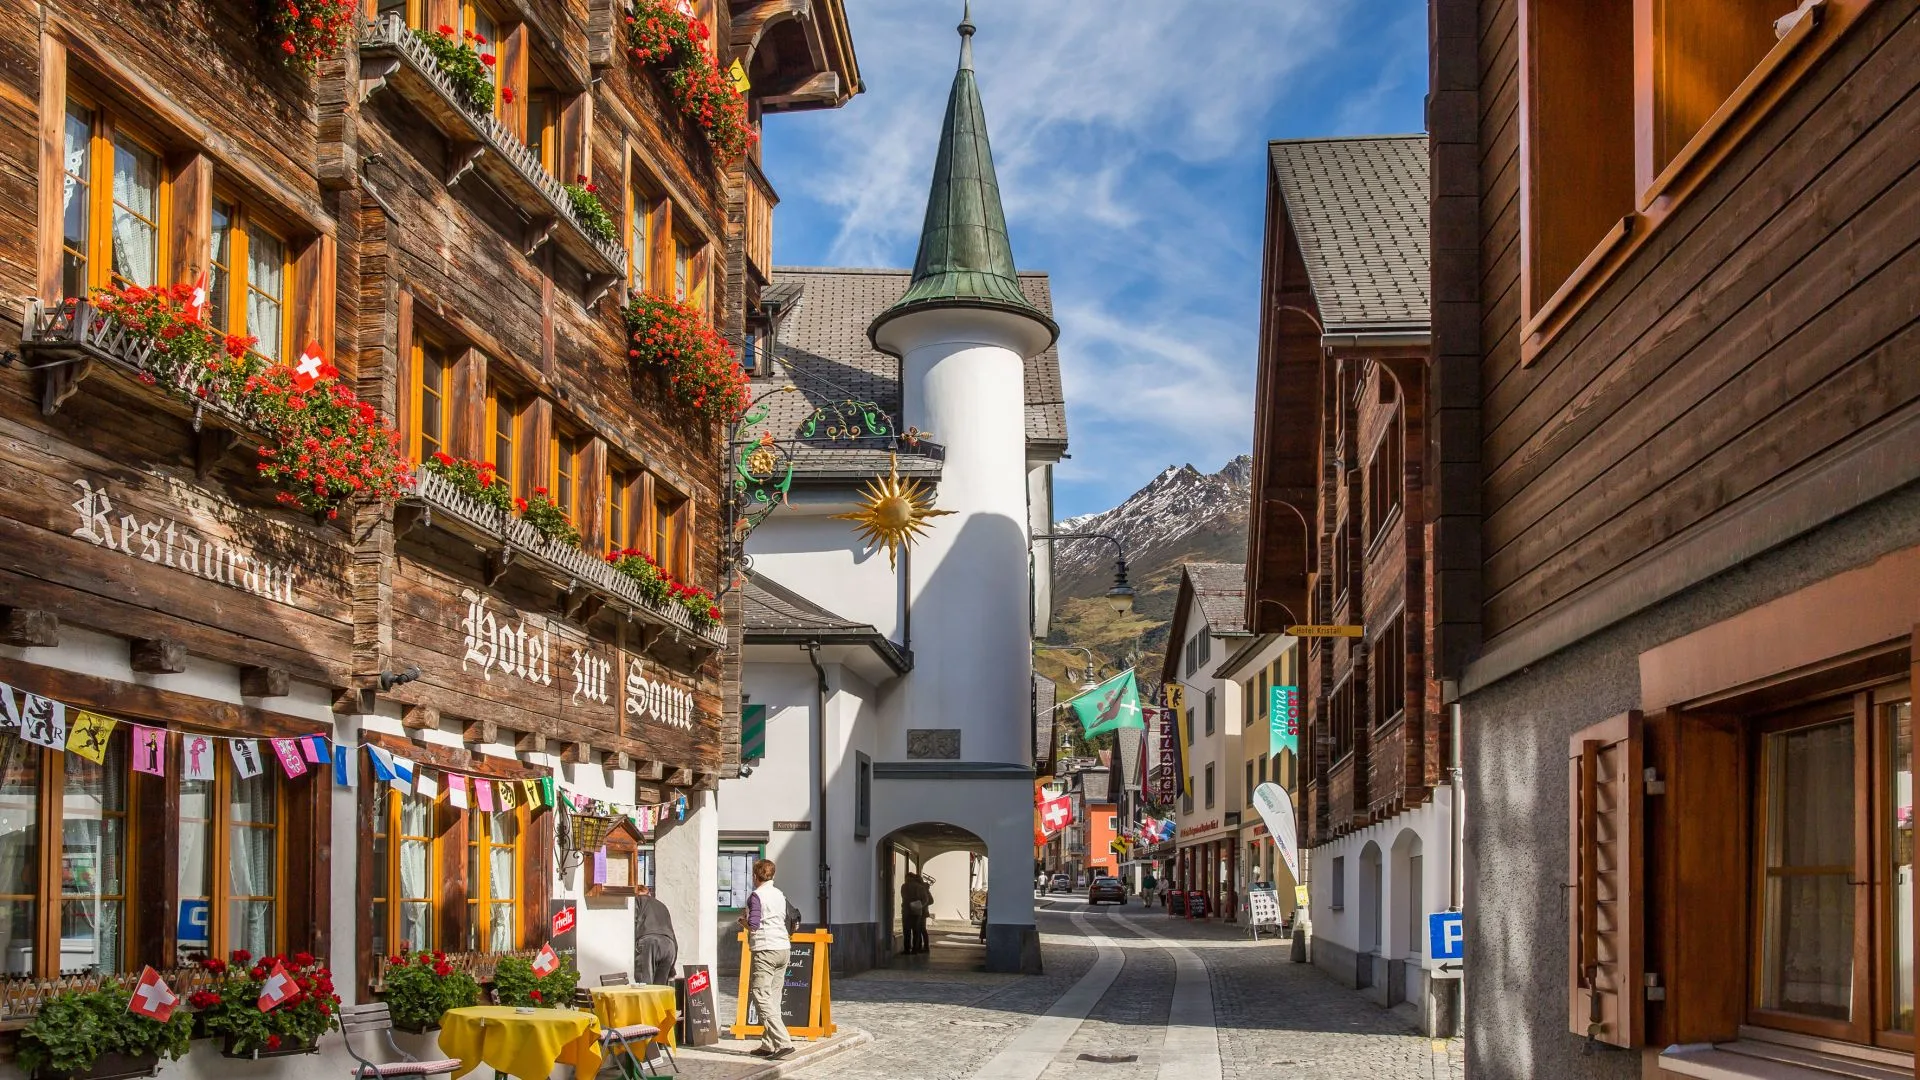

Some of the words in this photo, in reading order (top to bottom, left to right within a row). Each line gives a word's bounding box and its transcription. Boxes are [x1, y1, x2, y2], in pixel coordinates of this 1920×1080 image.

[71, 479, 296, 606] Restaurant
[1296, 626, 1314, 635] Hotel
[461, 588, 552, 687] Hotel
[571, 649, 611, 706] zur
[626, 657, 694, 731] Sonne
[1271, 689, 1288, 740] Alpina
[1287, 690, 1300, 736] SPORT
[555, 911, 573, 930] rivella
[1443, 920, 1464, 954] P
[691, 975, 707, 990] rivella
